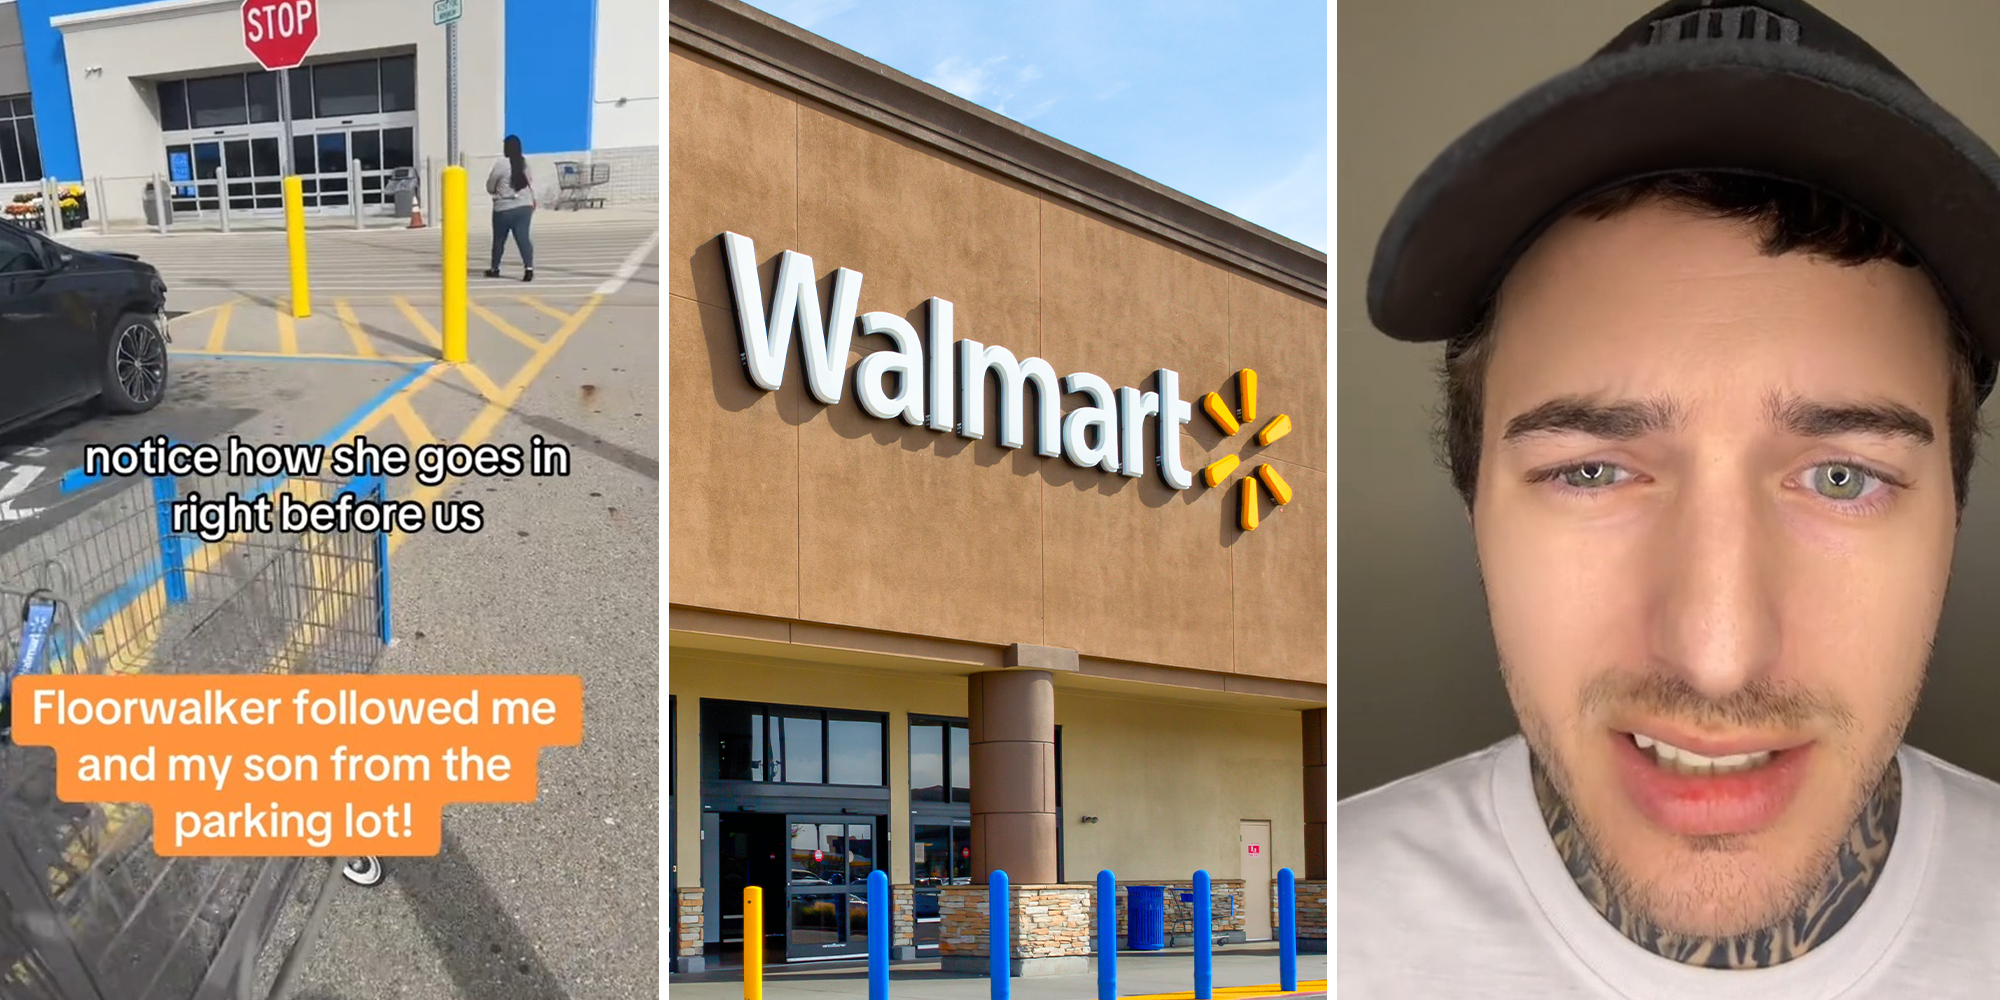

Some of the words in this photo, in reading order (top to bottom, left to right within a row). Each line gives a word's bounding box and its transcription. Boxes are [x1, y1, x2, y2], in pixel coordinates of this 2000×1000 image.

[247, 0, 312, 42] STOP
[721, 230, 1193, 490] Walmart
[18, 633, 41, 675] almart
